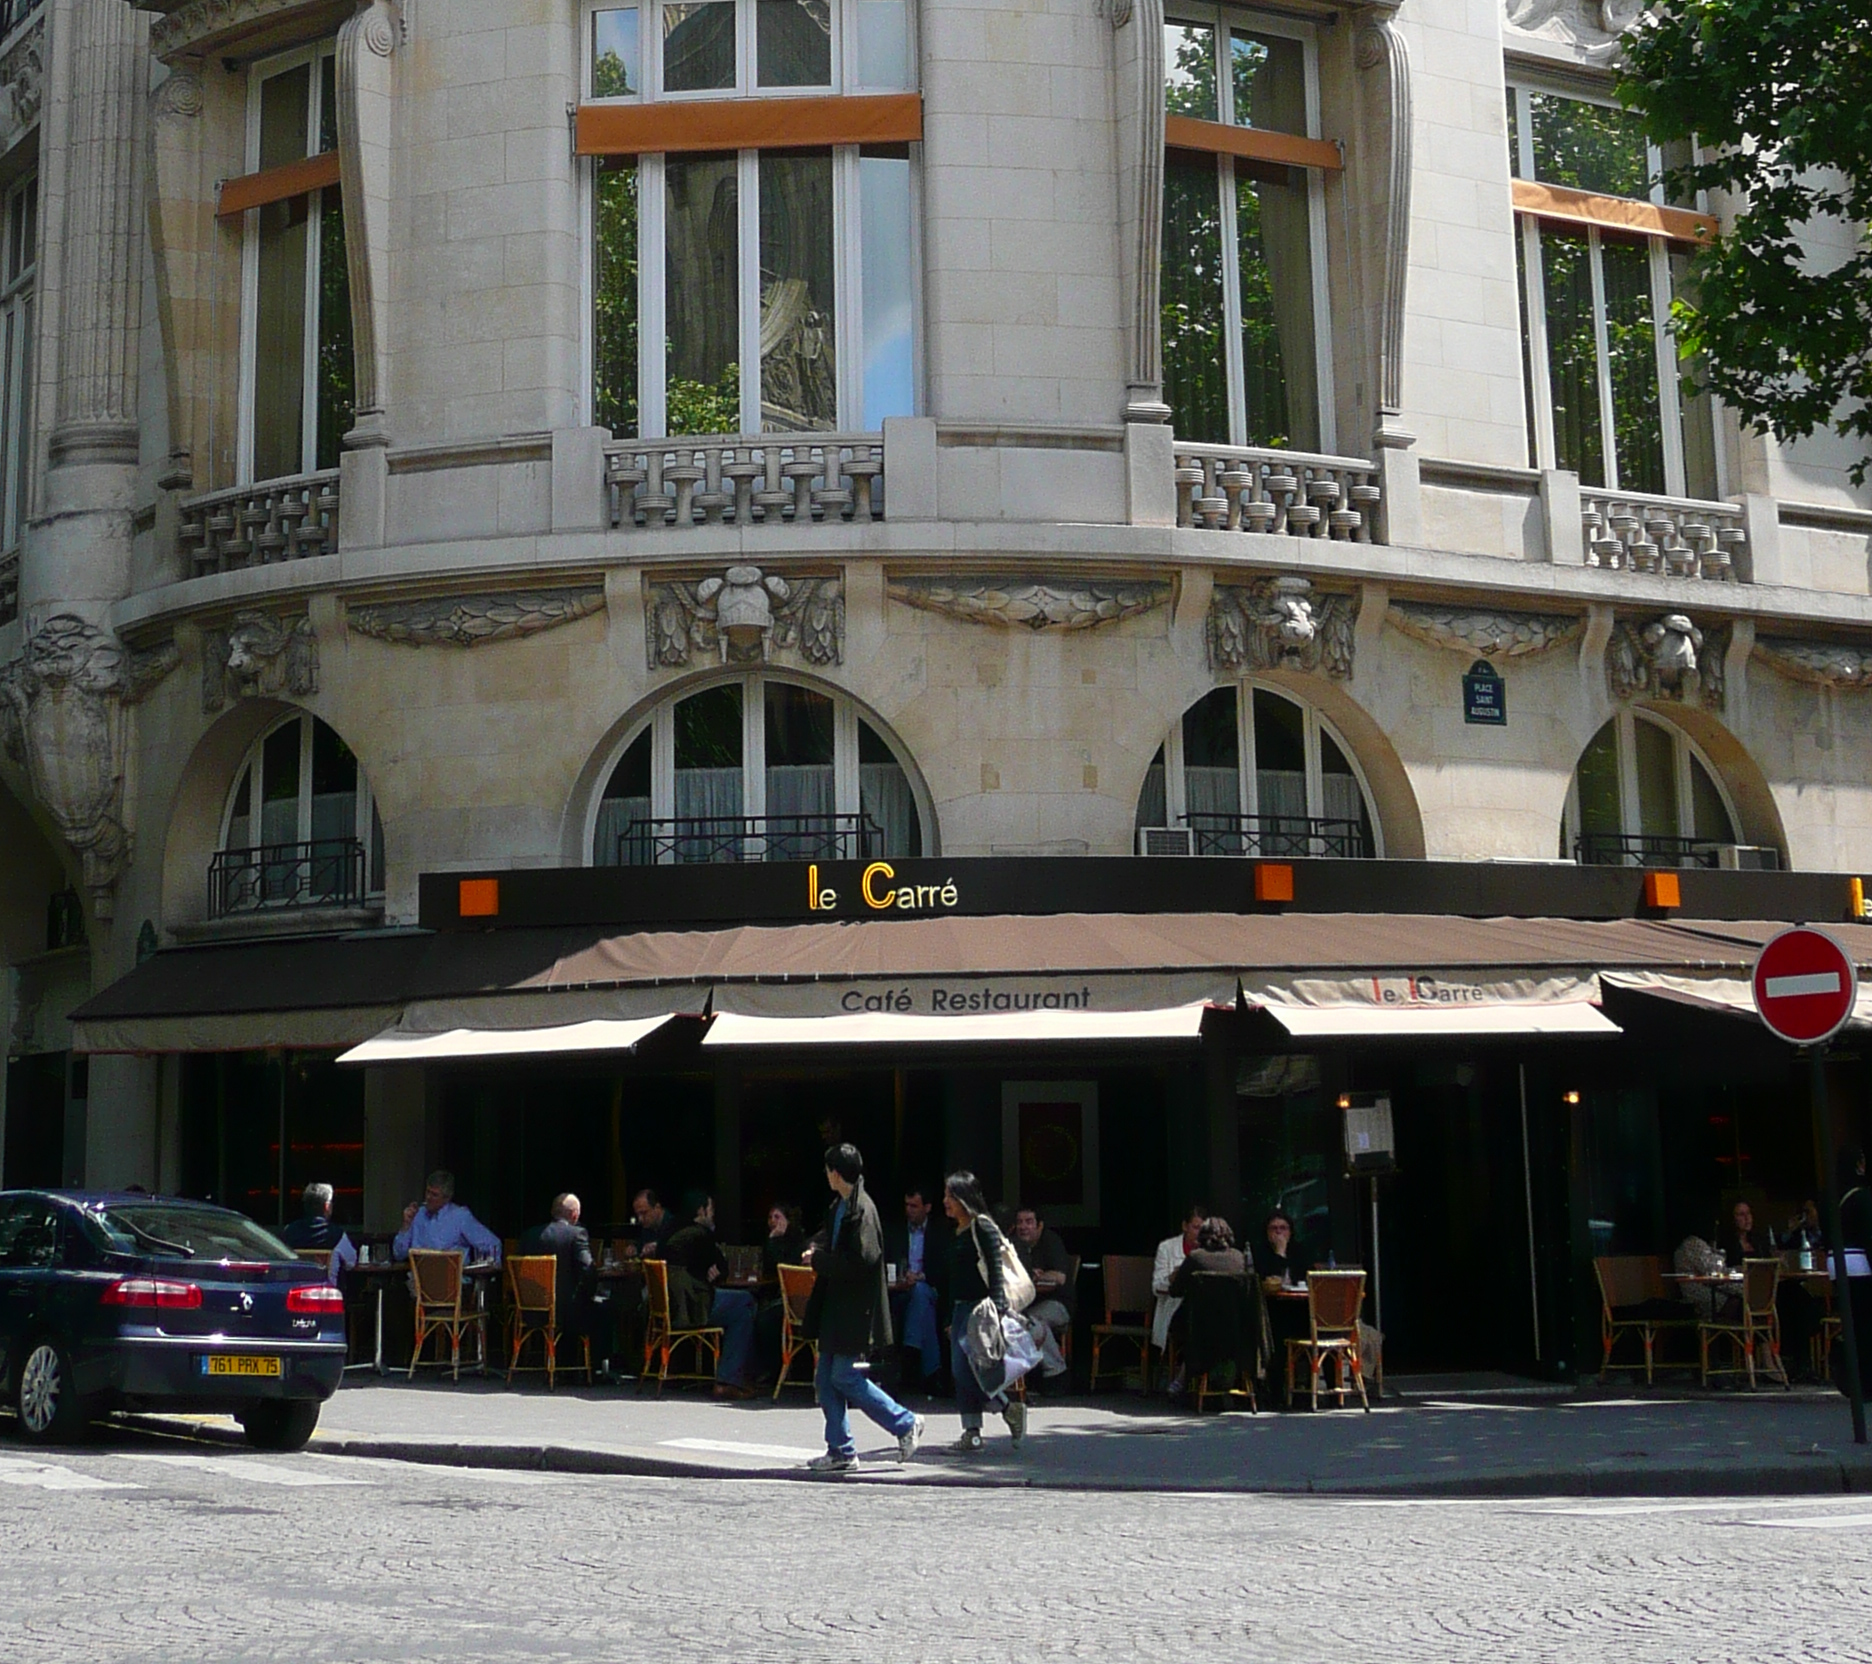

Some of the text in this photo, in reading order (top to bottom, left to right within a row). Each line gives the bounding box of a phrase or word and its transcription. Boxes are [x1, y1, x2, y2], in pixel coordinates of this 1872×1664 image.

[1473, 683, 1494, 693] PLACE
[1475, 695, 1494, 705] SAINT
[808, 862, 958, 910] le Carré
[841, 986, 1091, 1012] Café Restaurant
[211, 1357, 233, 1373] 761
[263, 1358, 278, 1374] 75
